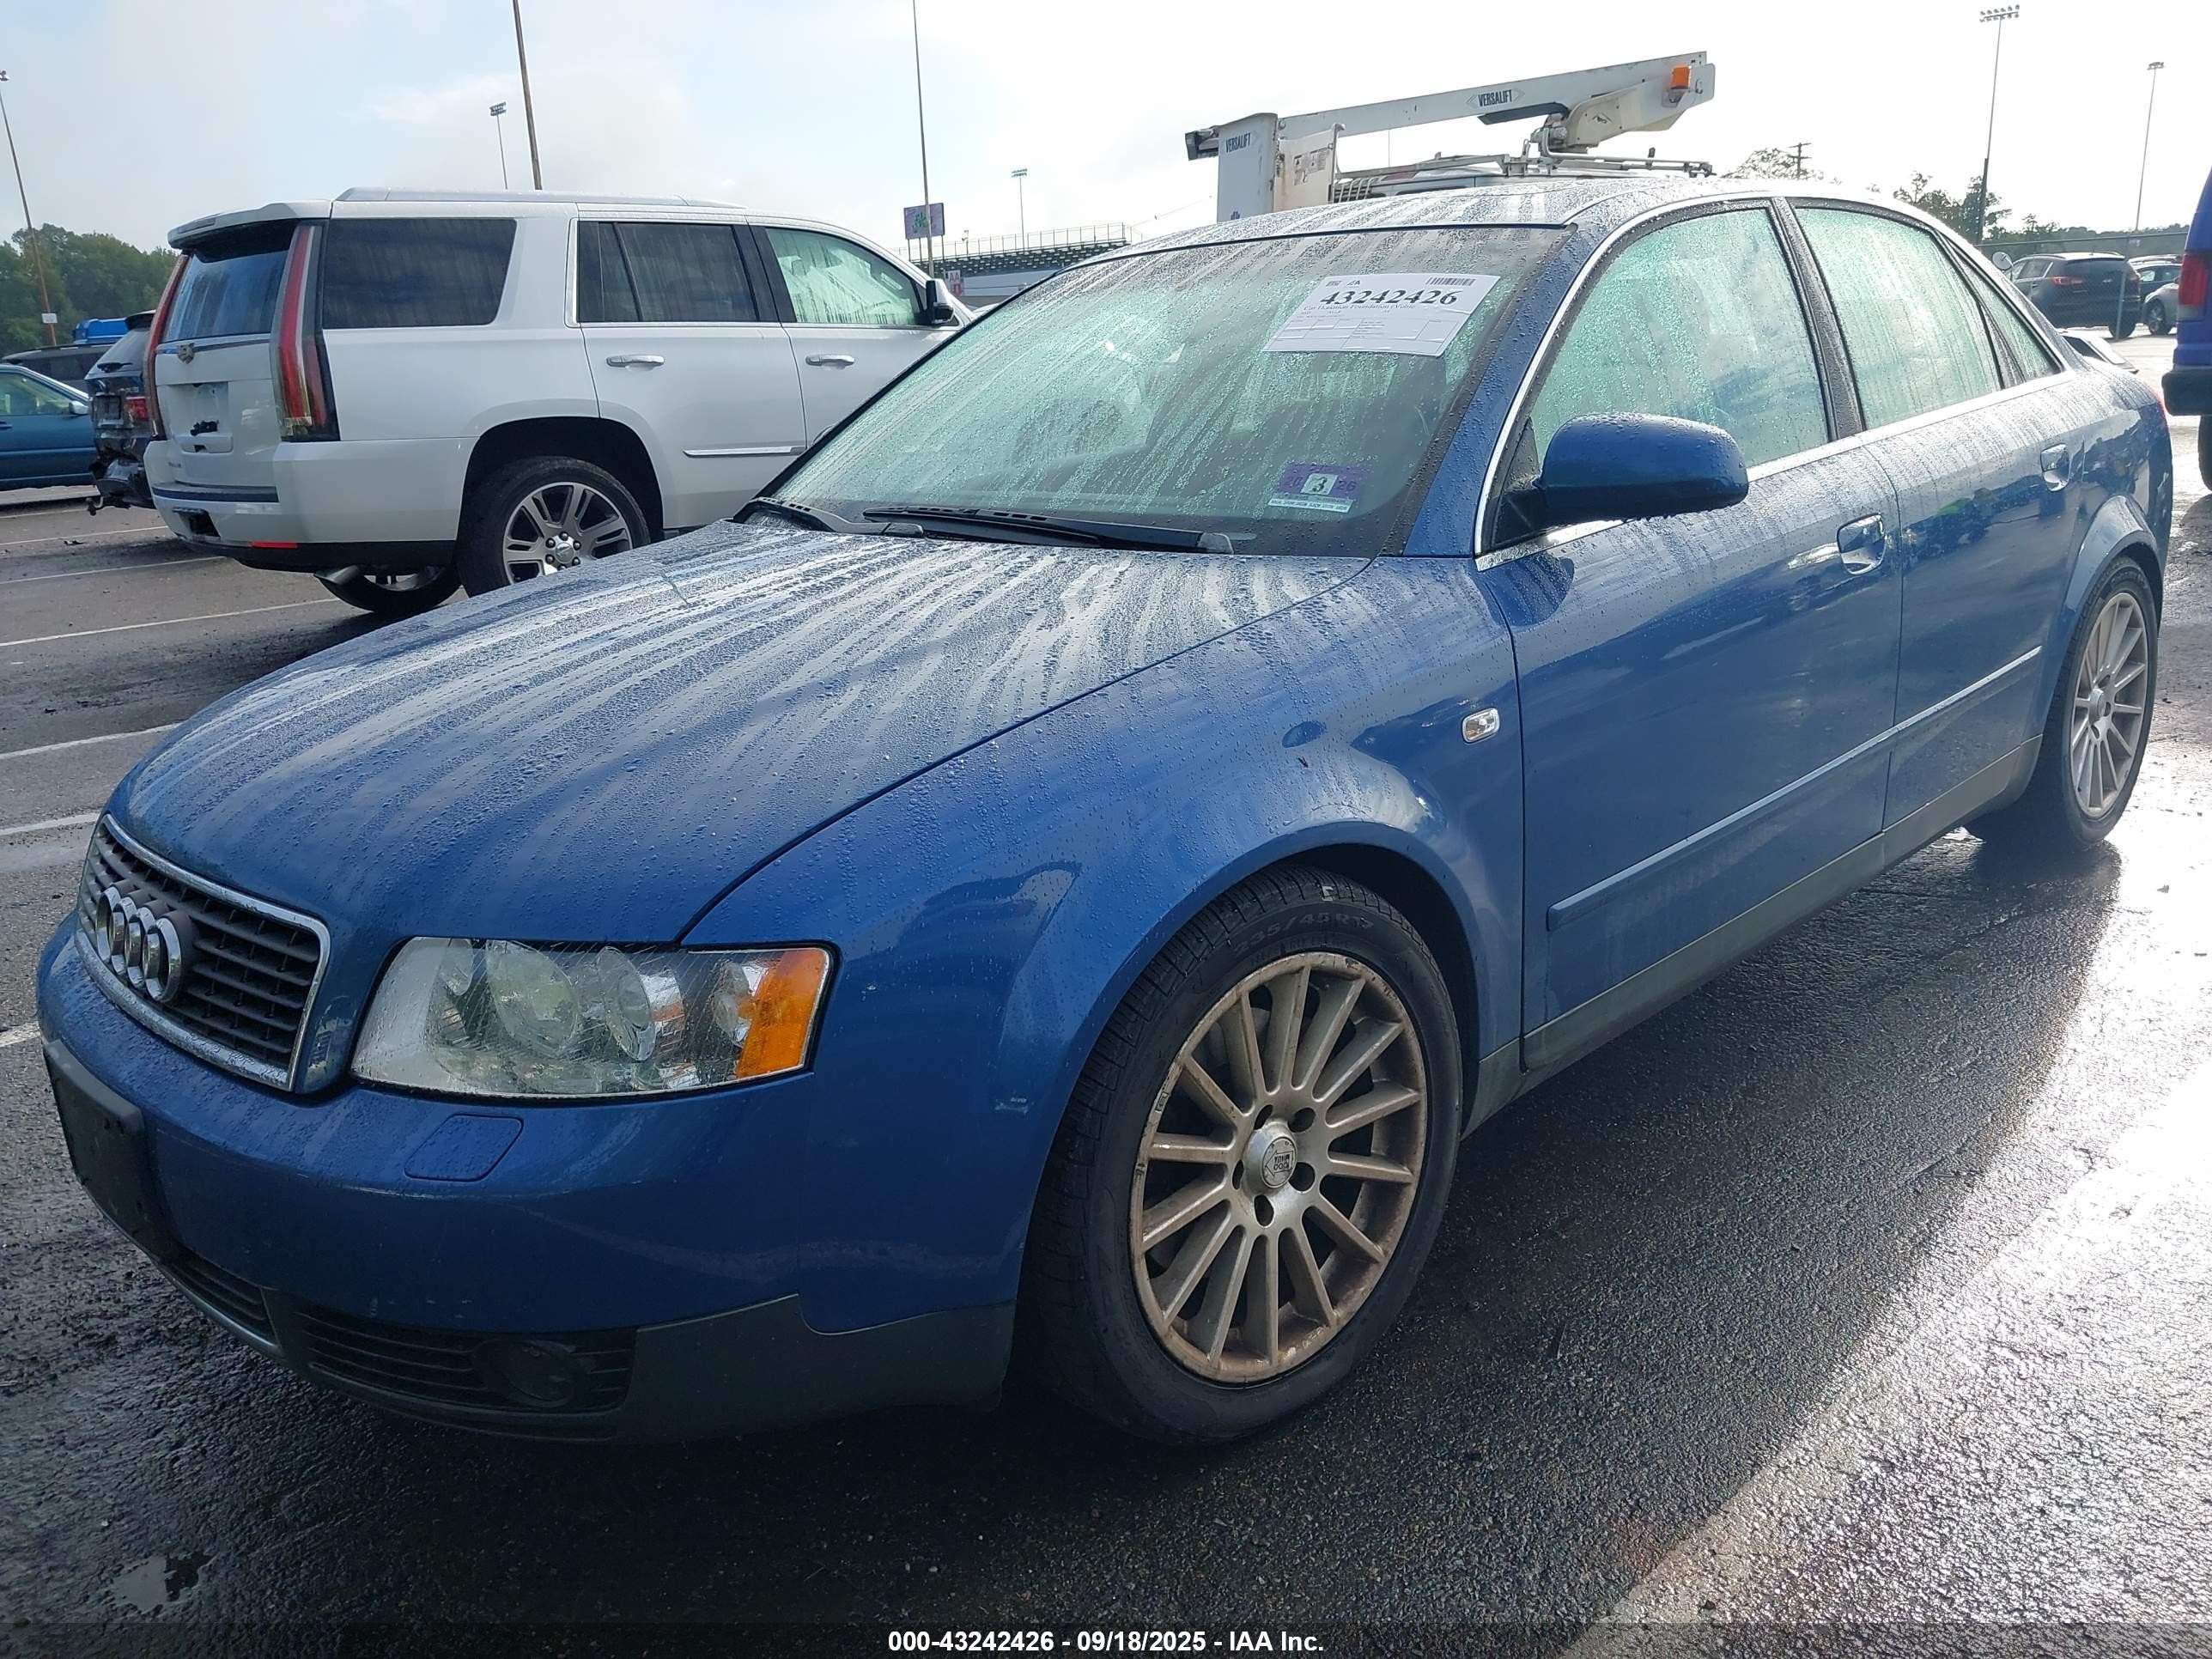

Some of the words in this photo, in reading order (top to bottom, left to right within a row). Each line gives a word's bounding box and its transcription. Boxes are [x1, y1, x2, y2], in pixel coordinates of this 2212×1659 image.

[1478, 89, 1512, 106] VERSALIFT
[1225, 132, 1251, 153] VERSALIFT
[1320, 289, 1463, 305] 43242426
[1312, 476, 1328, 492] 3
[1338, 479, 1358, 492] 26
